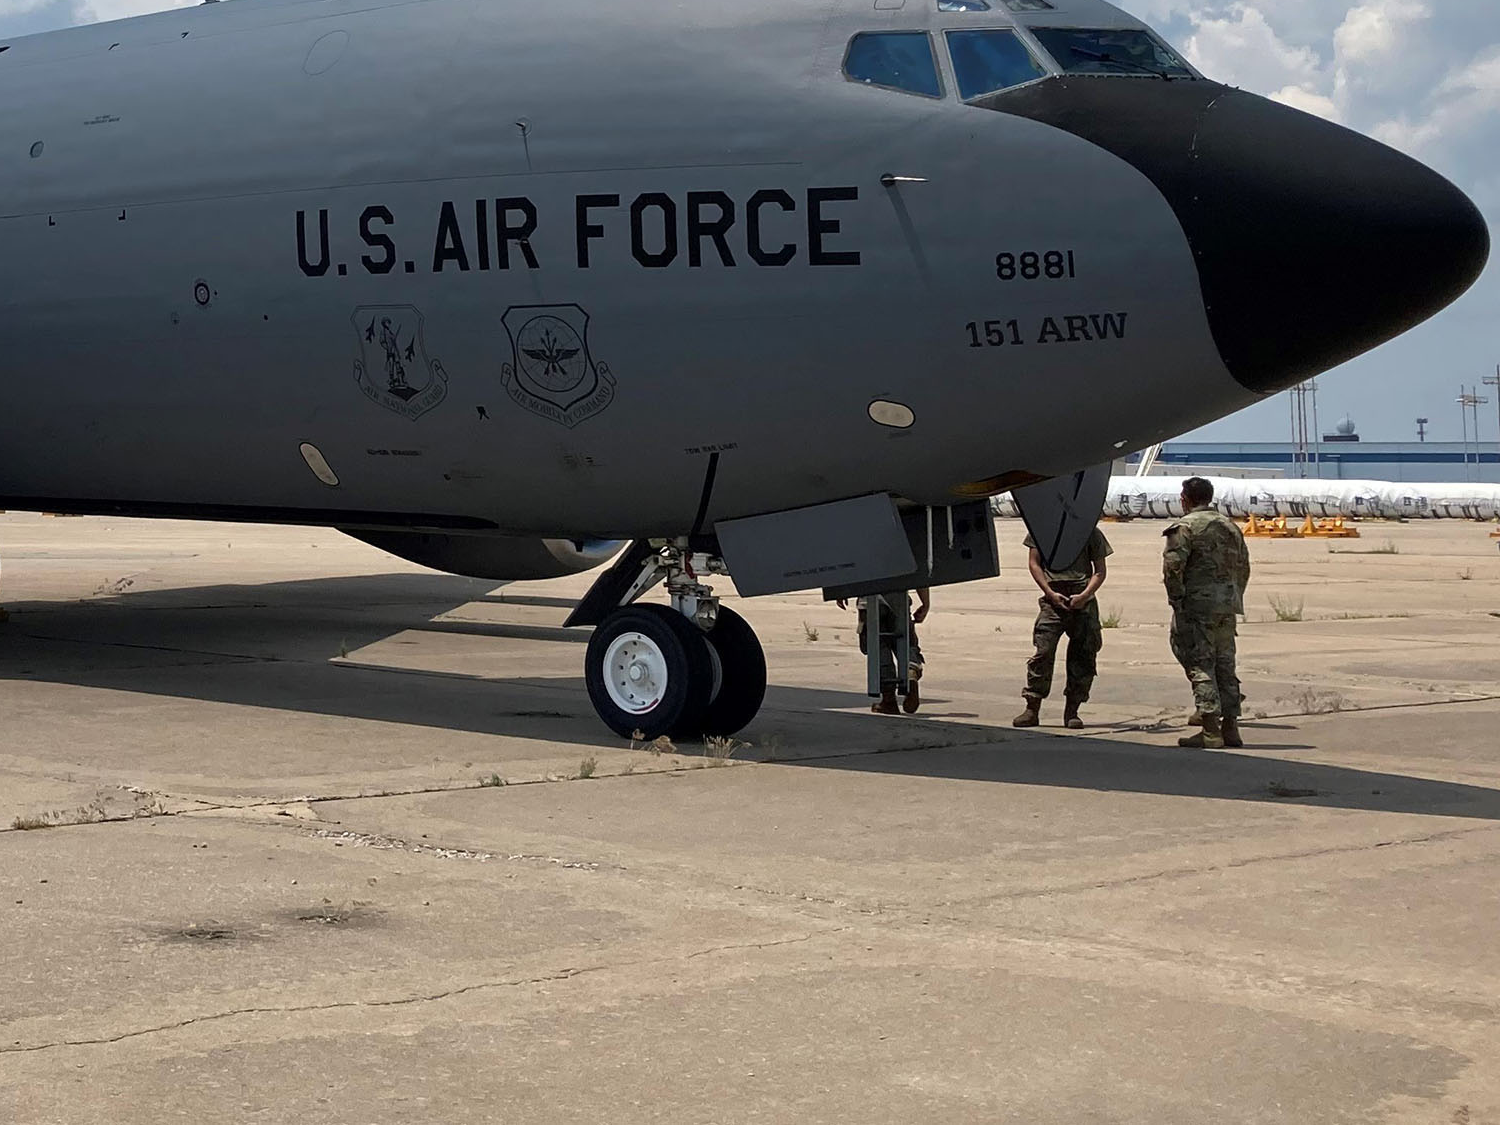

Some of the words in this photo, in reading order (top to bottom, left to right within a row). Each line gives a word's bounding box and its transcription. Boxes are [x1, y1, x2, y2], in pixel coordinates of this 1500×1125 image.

[296, 205, 415, 277] U.S.
[432, 196, 540, 273] AIR
[575, 186, 861, 268] FORCE
[995, 249, 1076, 281] 8881
[965, 319, 1024, 348] 151
[1037, 312, 1128, 344] ARW
[511, 388, 527, 405] AIR
[573, 386, 610, 419] COMMAND
